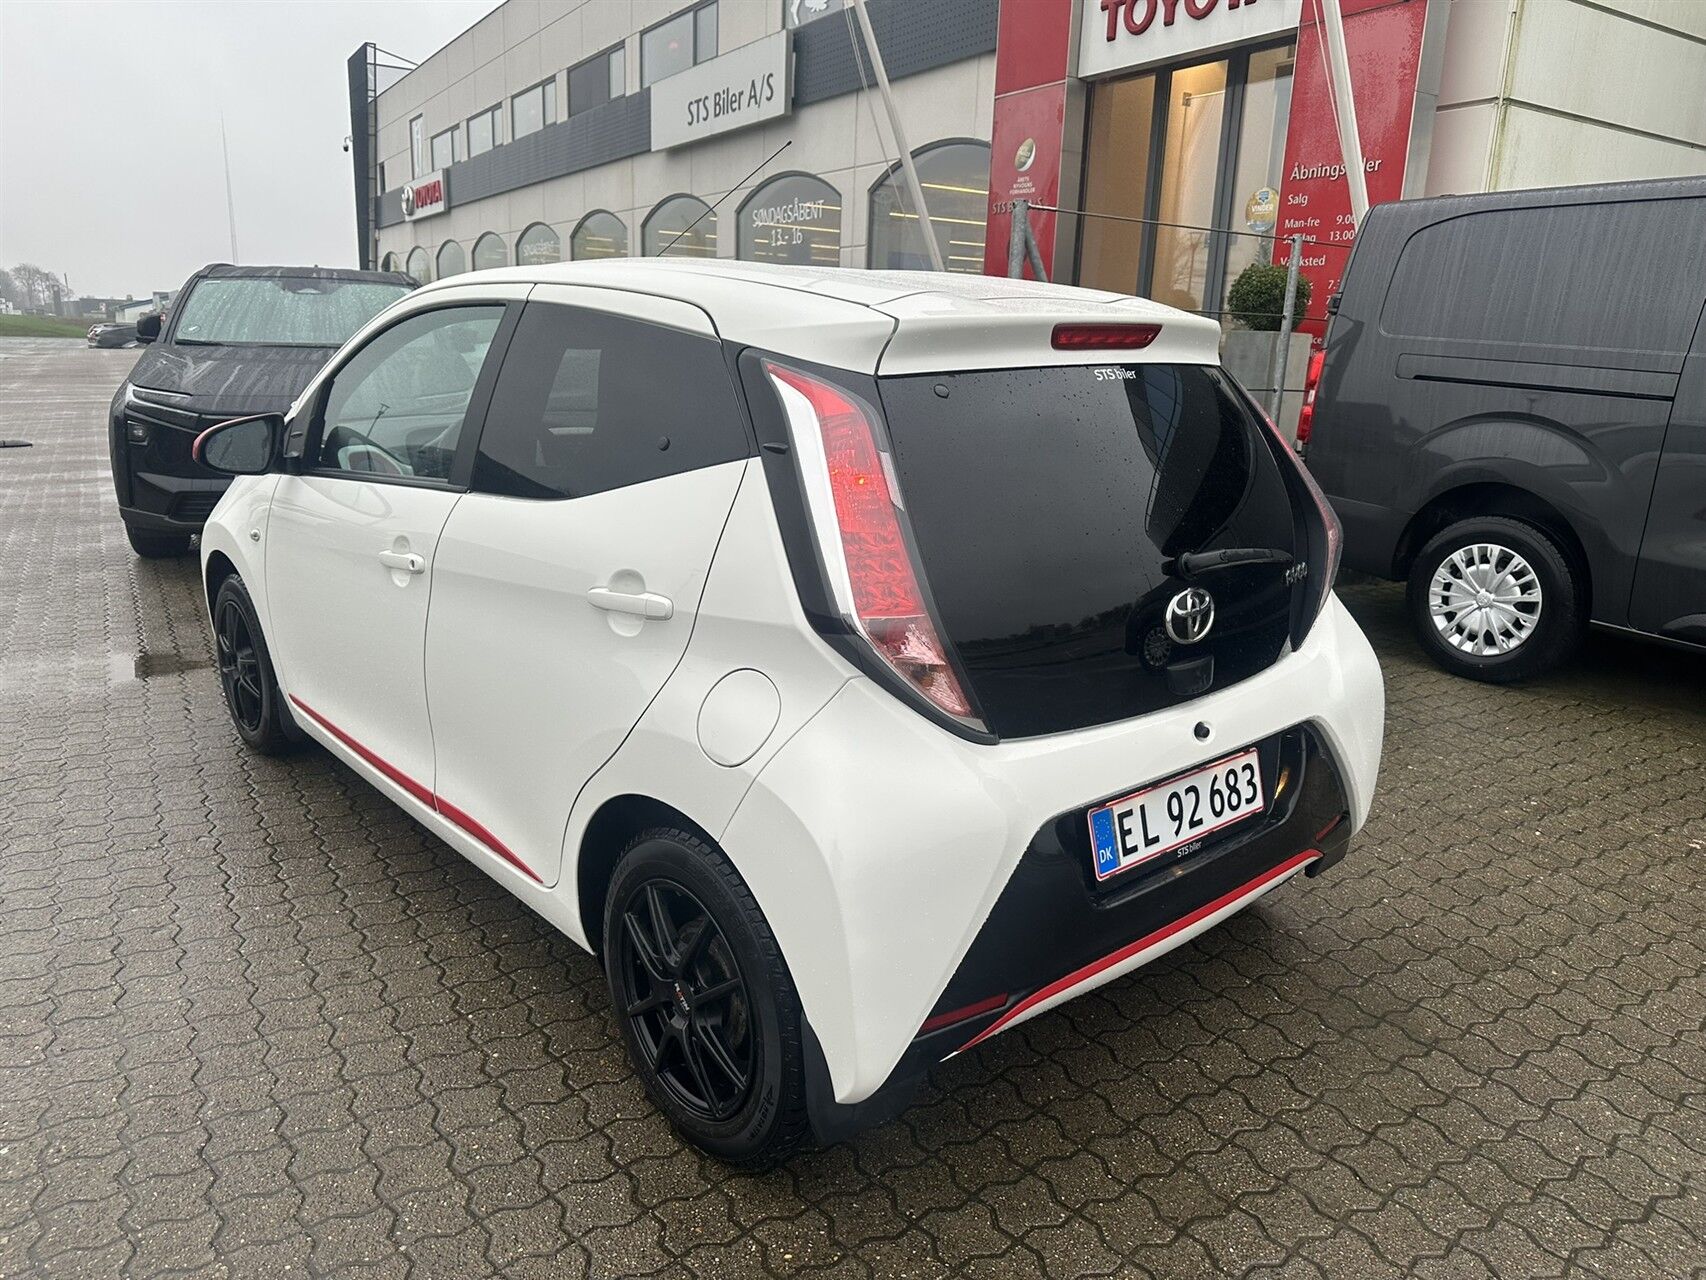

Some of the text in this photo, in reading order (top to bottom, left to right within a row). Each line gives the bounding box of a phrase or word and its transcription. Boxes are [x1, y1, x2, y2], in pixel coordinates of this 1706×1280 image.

[687, 72, 774, 126] STS Biler A/S
[1287, 193, 1309, 207] Salg
[1284, 216, 1320, 229] Man-fre
[1329, 229, 1355, 241] 13.00
[1094, 368, 1136, 381] STS biler
[1117, 762, 1259, 857] EL 92 683
[1099, 846, 1114, 864] DK
[1177, 845, 1189, 858] STS
